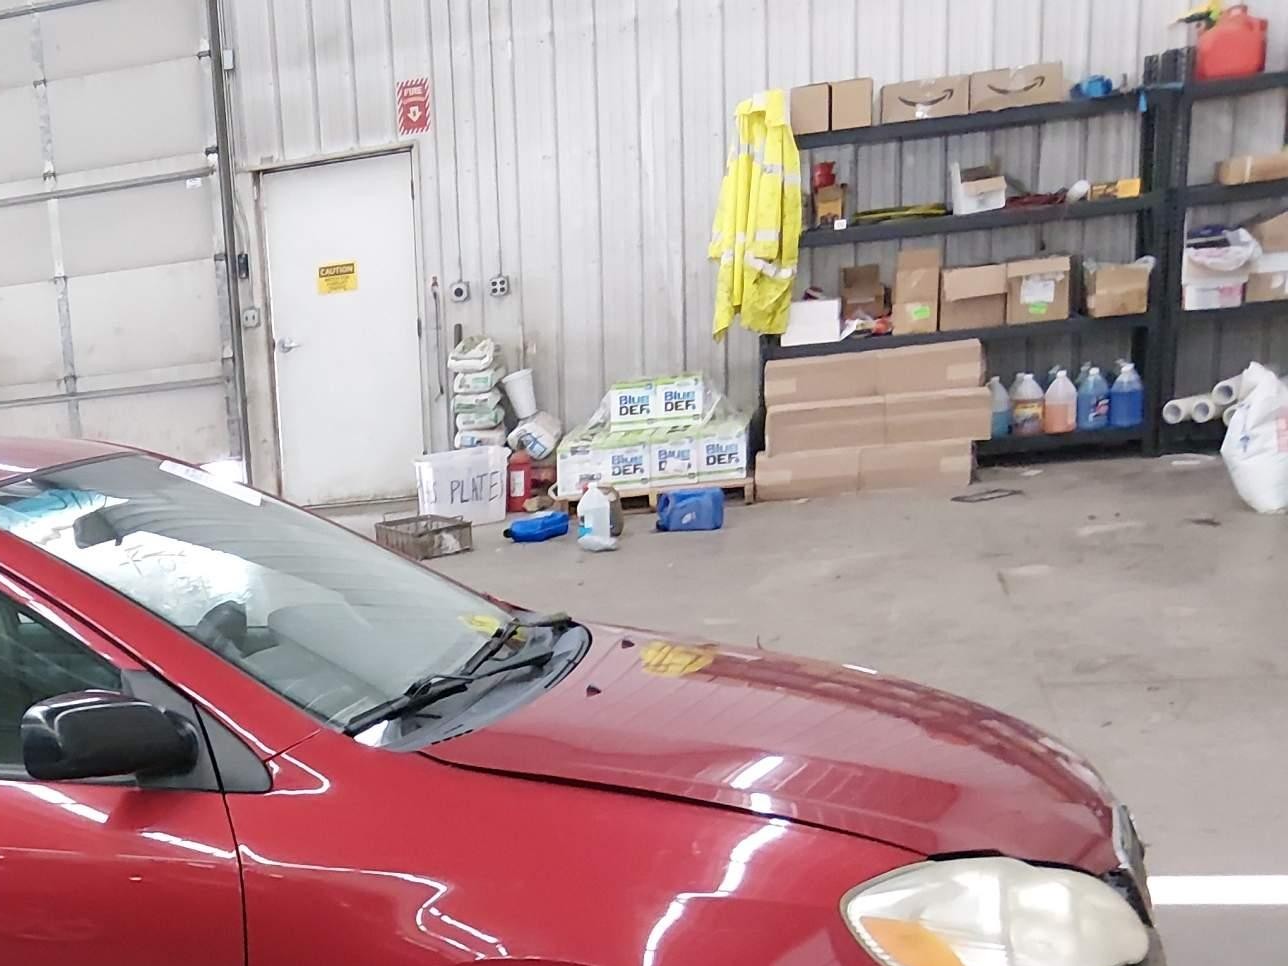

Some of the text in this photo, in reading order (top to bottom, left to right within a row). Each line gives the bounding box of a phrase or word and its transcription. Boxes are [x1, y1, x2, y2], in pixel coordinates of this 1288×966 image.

[320, 264, 352, 276] CAUTION
[618, 395, 649, 405] Blue
[664, 390, 696, 401] Blue
[618, 404, 650, 416] DEF
[664, 400, 696, 412] DEF
[705, 452, 739, 466] DEF
[611, 463, 644, 476] DEF
